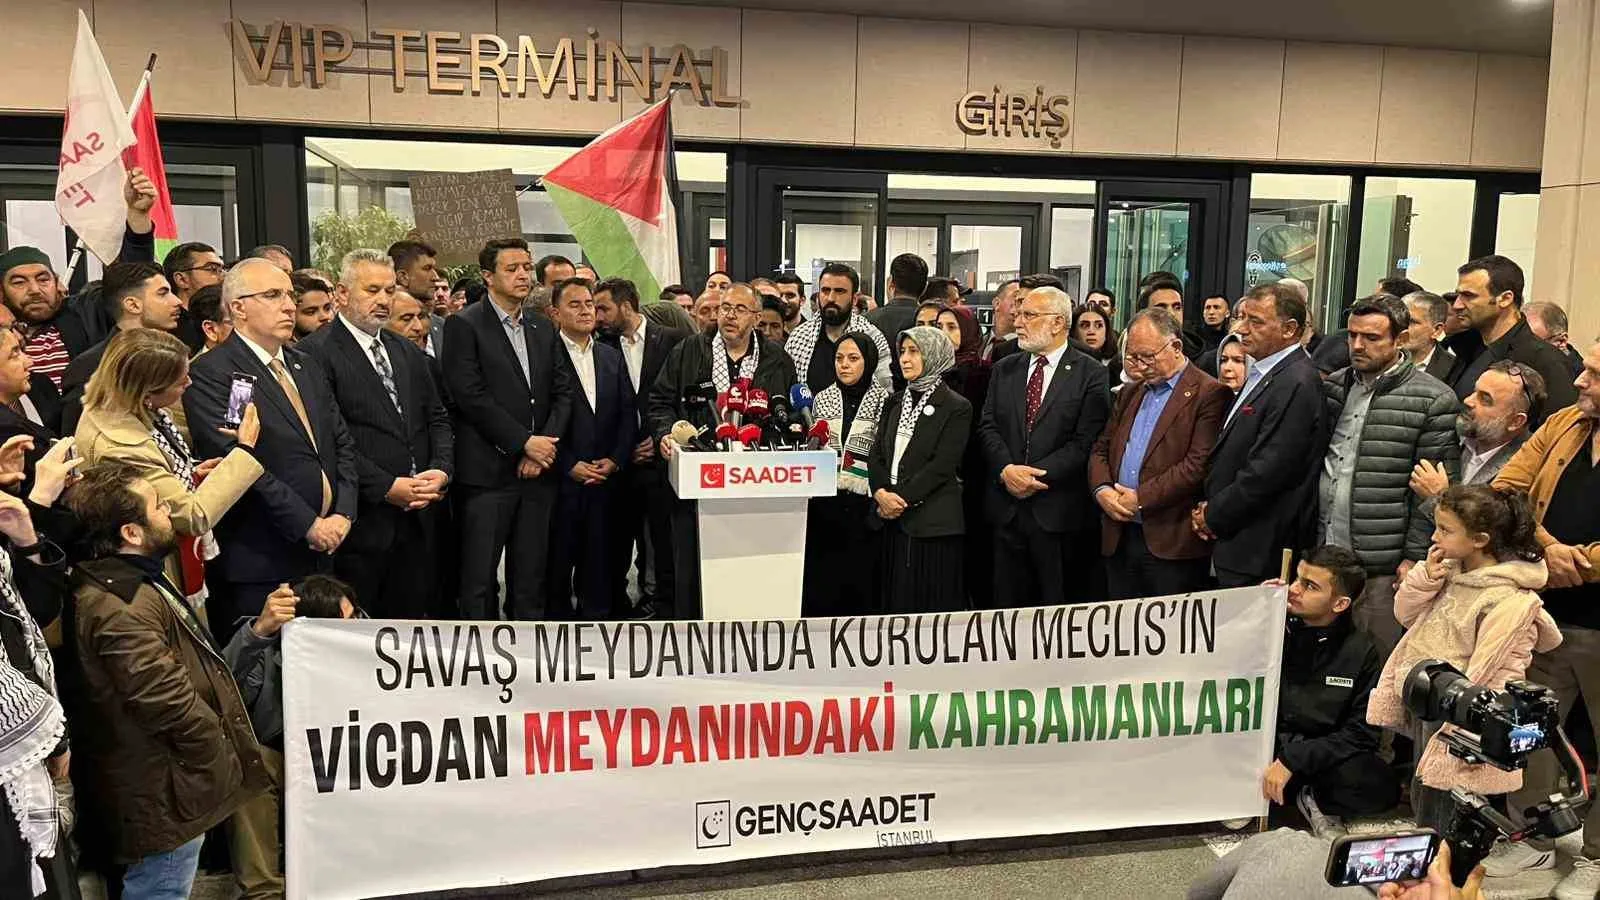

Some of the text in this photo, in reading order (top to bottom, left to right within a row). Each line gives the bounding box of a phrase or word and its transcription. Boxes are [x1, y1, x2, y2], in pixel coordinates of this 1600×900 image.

[229, 18, 745, 106] VIP TERMİNAL
[957, 85, 1070, 149] GİRİŞ
[729, 466, 817, 484] SAADET
[375, 626, 518, 703] SAVAŞ
[535, 618, 815, 683] MEYDANINDA
[830, 610, 1019, 669] KURULAN
[306, 676, 1265, 794] VİCDAN MEYDANINDAKİ KAHRAMANLARI
[735, 793, 936, 836] GENÇSAADET
